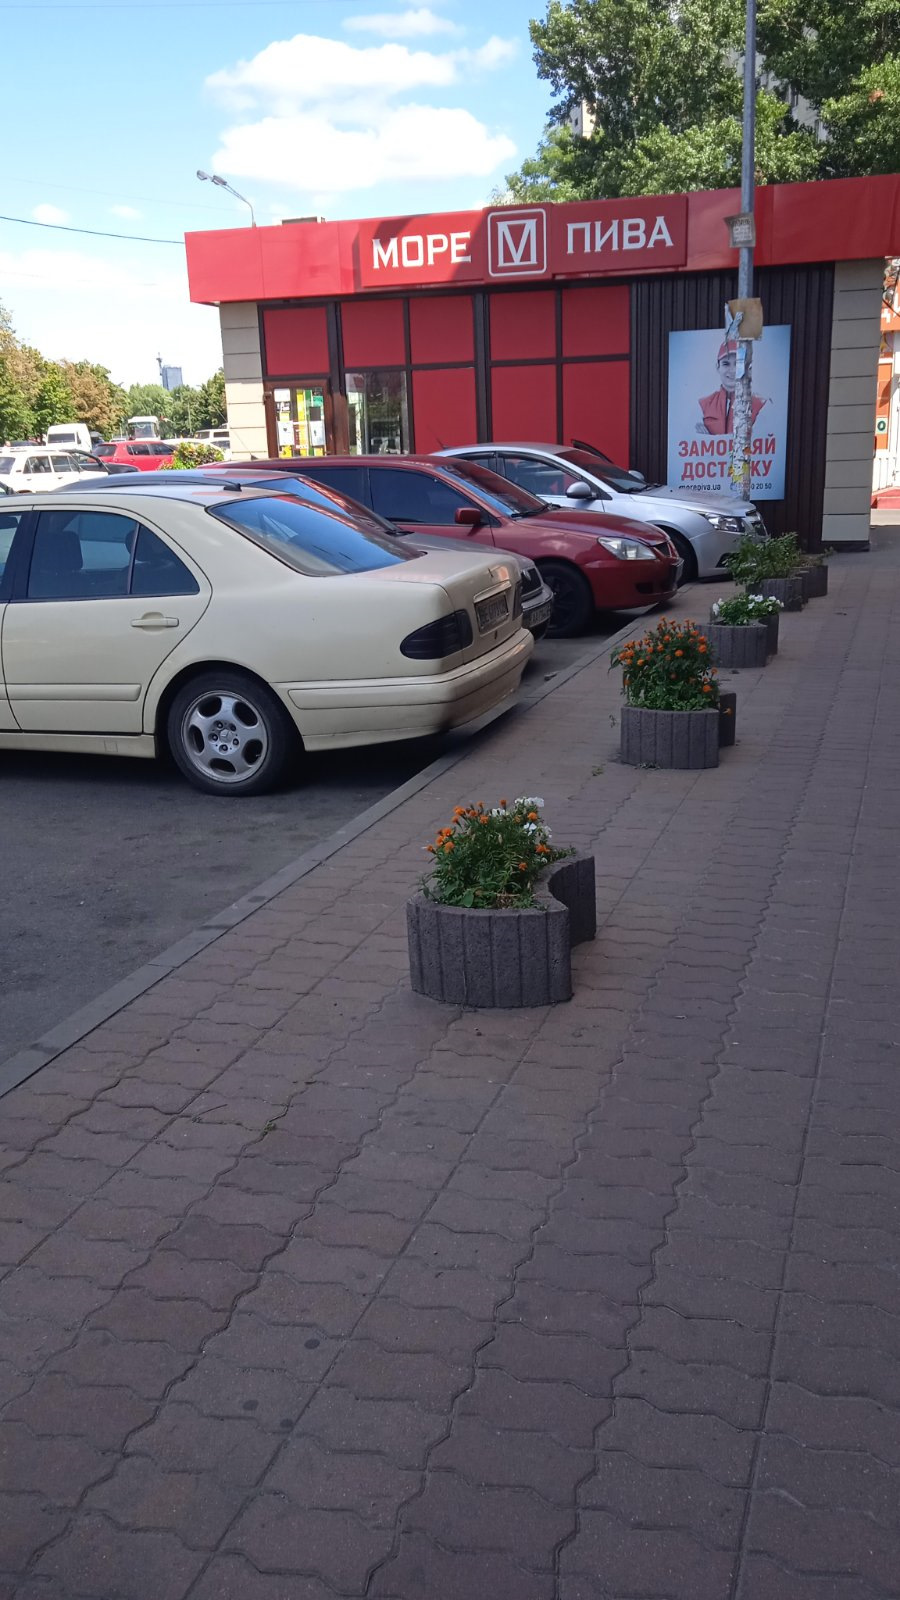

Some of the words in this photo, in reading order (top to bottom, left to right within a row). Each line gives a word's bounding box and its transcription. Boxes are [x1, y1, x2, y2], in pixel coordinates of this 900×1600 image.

[372, 232, 471, 269] МОРЕ
[566, 216, 674, 254] ПИВА
[678, 434, 776, 457] ЗАМОЯЙ
[681, 460, 772, 481] ДОСТКУ
